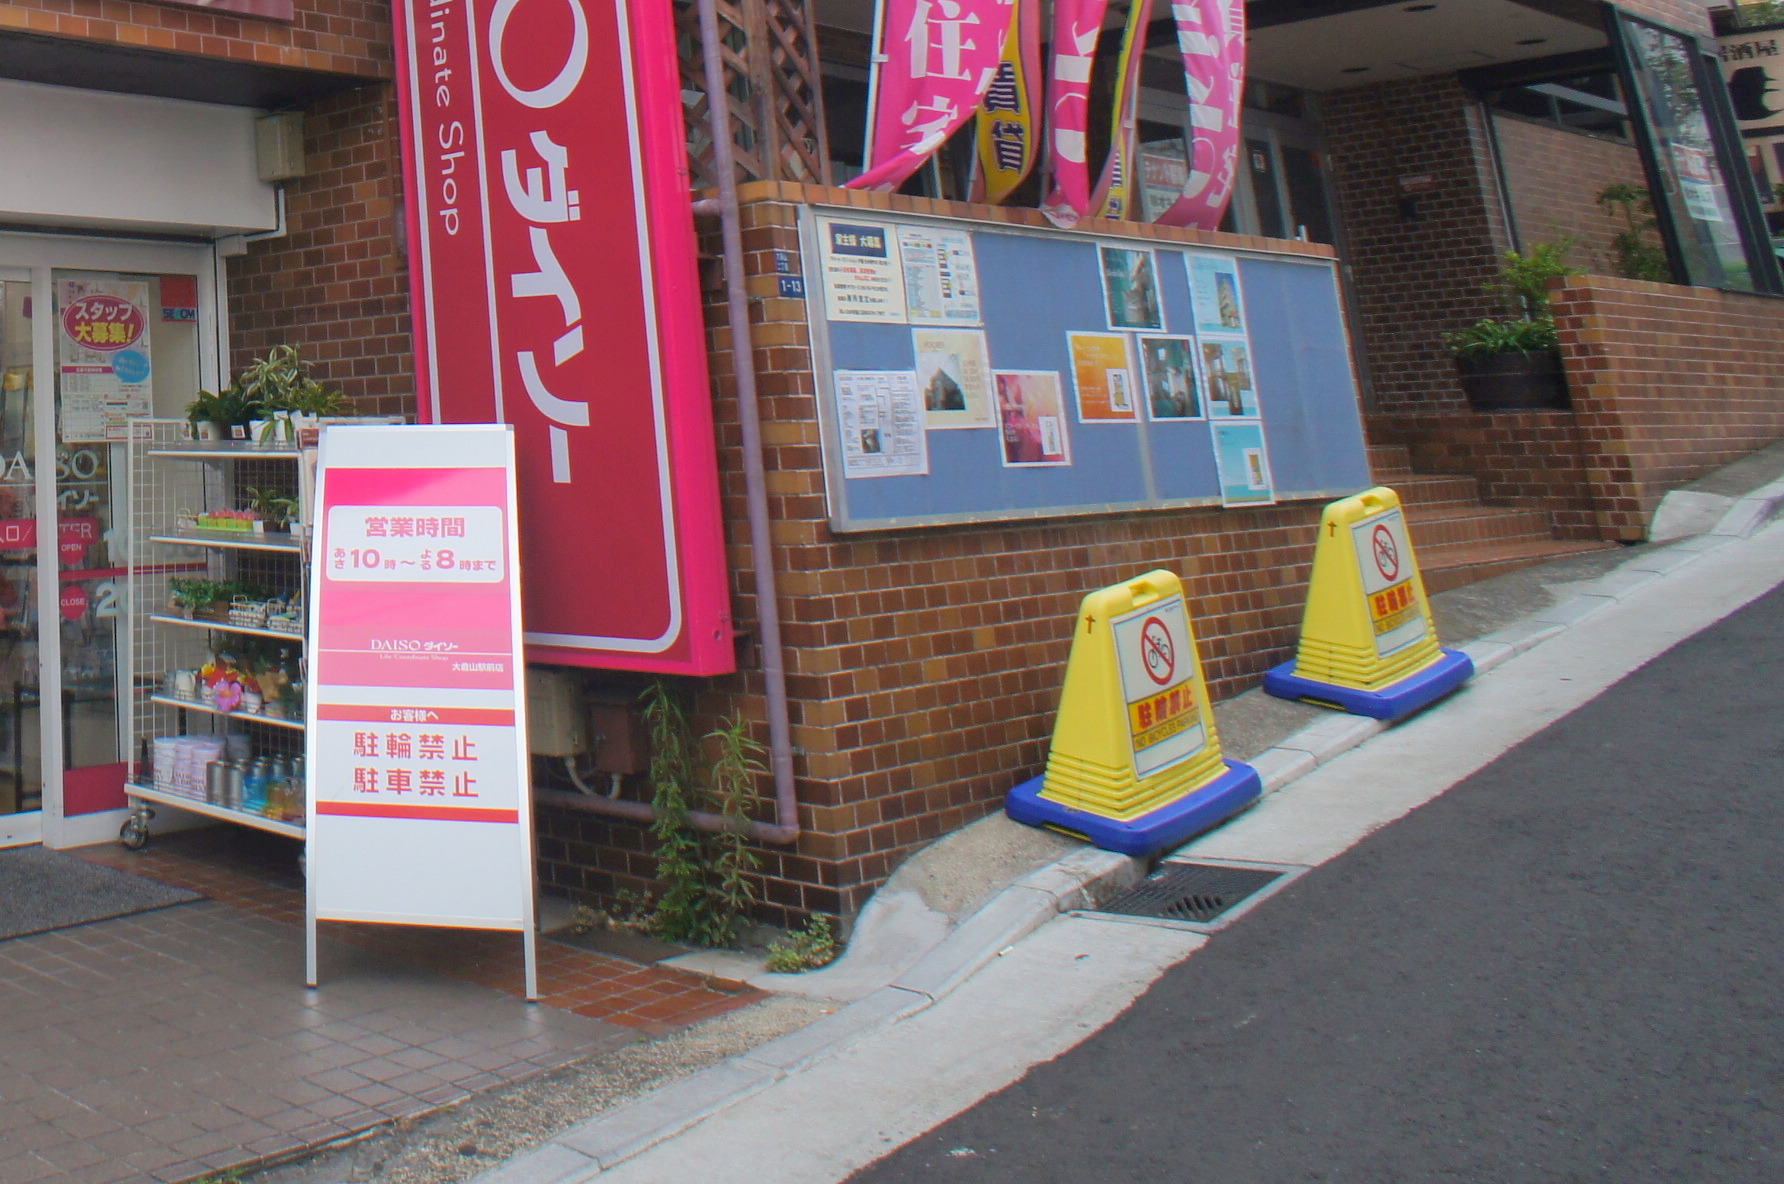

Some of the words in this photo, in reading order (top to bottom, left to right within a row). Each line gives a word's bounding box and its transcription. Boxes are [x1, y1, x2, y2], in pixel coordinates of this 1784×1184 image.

[438, 120, 466, 237] Shop
[781, 279, 802, 293] 1-13
[75, 302, 134, 321] スタッフ
[500, 130, 591, 484] ダイソー
[365, 516, 465, 538] 営業時間
[61, 543, 82, 552] OPEN
[60, 598, 85, 607] CLOSE
[371, 639, 421, 651] DAISO
[423, 641, 459, 651] ダイソー
[390, 708, 439, 722] お客様へ
[353, 731, 478, 762] 駐輪禁止
[353, 767, 479, 798] 駐車禁止
